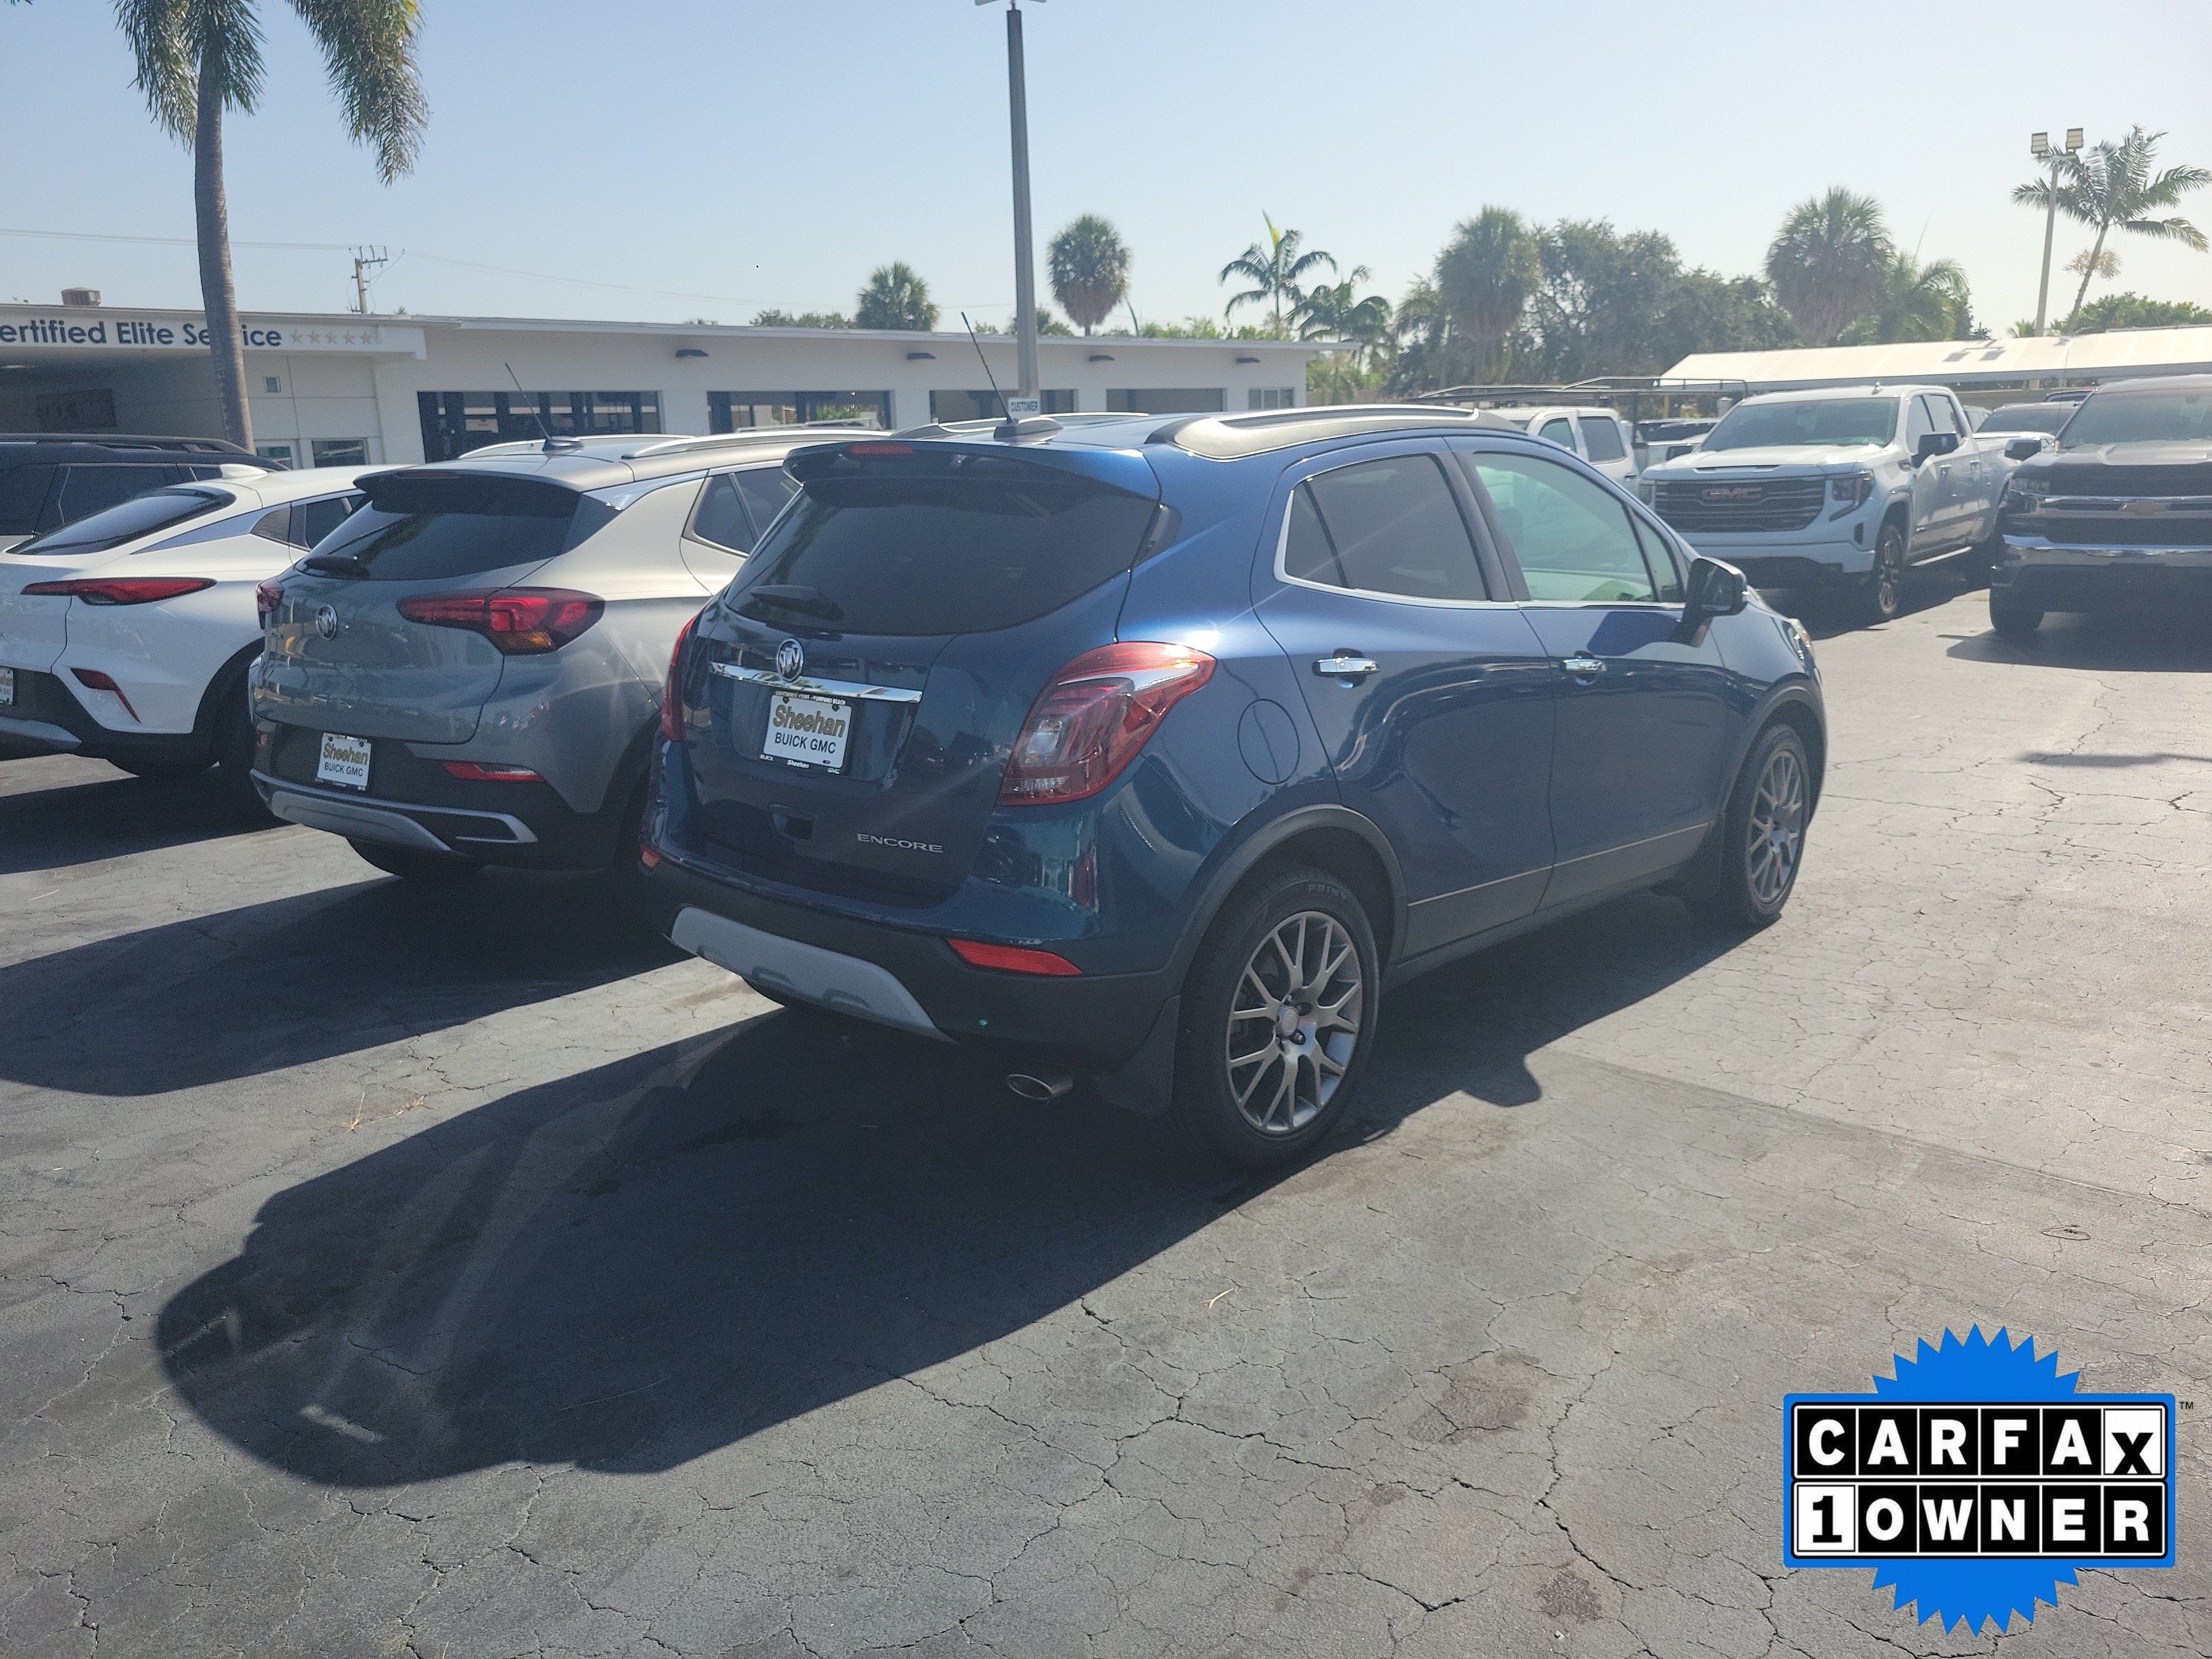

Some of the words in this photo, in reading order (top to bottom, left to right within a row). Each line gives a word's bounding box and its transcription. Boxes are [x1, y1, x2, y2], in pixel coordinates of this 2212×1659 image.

[0, 319, 107, 343] ertified
[116, 321, 174, 345] Elite
[183, 323, 282, 346] Seice
[1702, 488, 1762, 500] GMC
[813, 696, 832, 704] POMPANO
[773, 704, 847, 737] Sheehan
[775, 732, 808, 749] BUICK
[810, 738, 837, 754] GMC
[323, 742, 369, 766] Sheehan
[787, 759, 810, 769] Sheehan
[324, 761, 345, 774] BUICK
[346, 766, 363, 777] GMC
[857, 833, 943, 853] ENCORE
